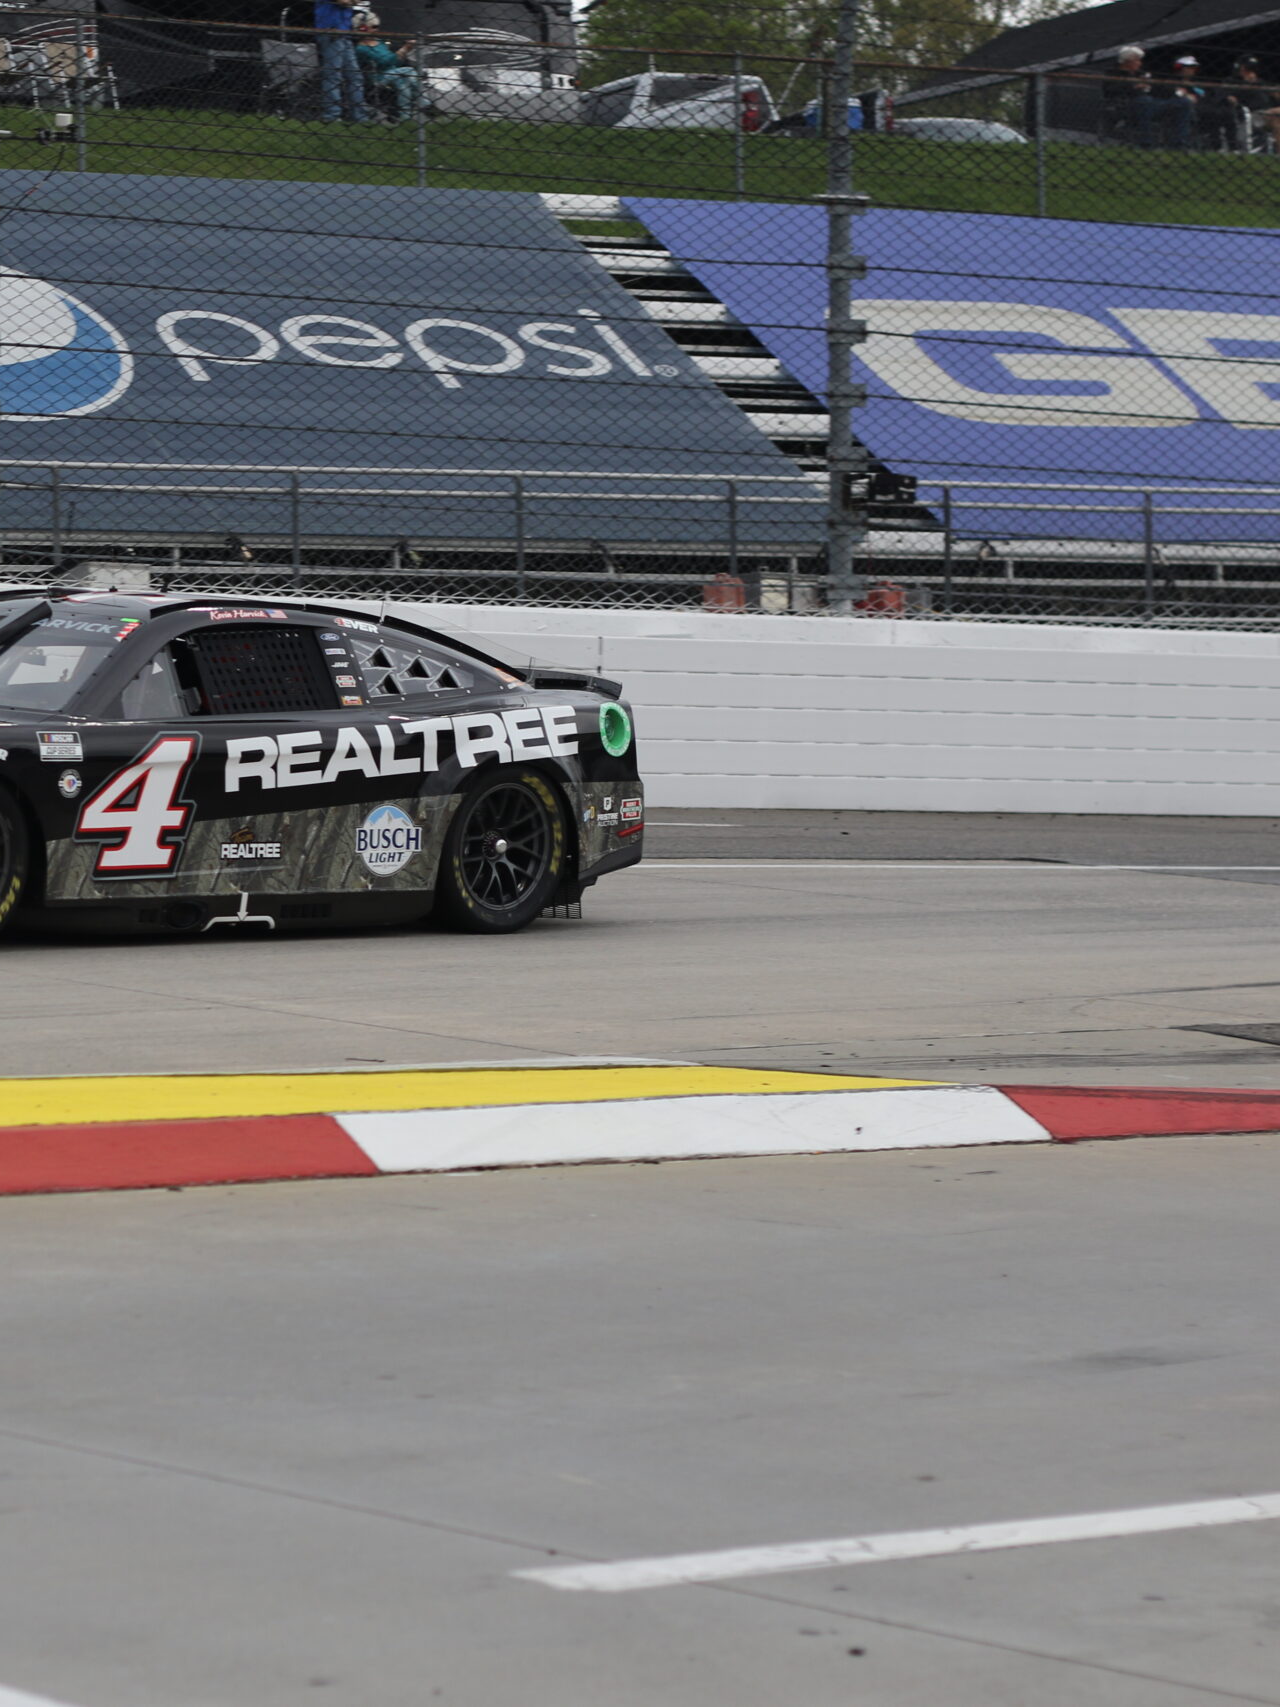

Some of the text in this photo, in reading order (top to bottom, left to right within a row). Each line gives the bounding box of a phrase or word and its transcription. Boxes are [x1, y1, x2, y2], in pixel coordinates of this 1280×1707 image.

[155, 308, 654, 389] pepsi
[32, 617, 118, 634] ARVICK
[225, 705, 579, 792] REALTREE
[77, 737, 195, 870] 4
[221, 842, 281, 859] REALTREE
[356, 827, 420, 851] BUSCH
[368, 852, 404, 864] LIGHT
